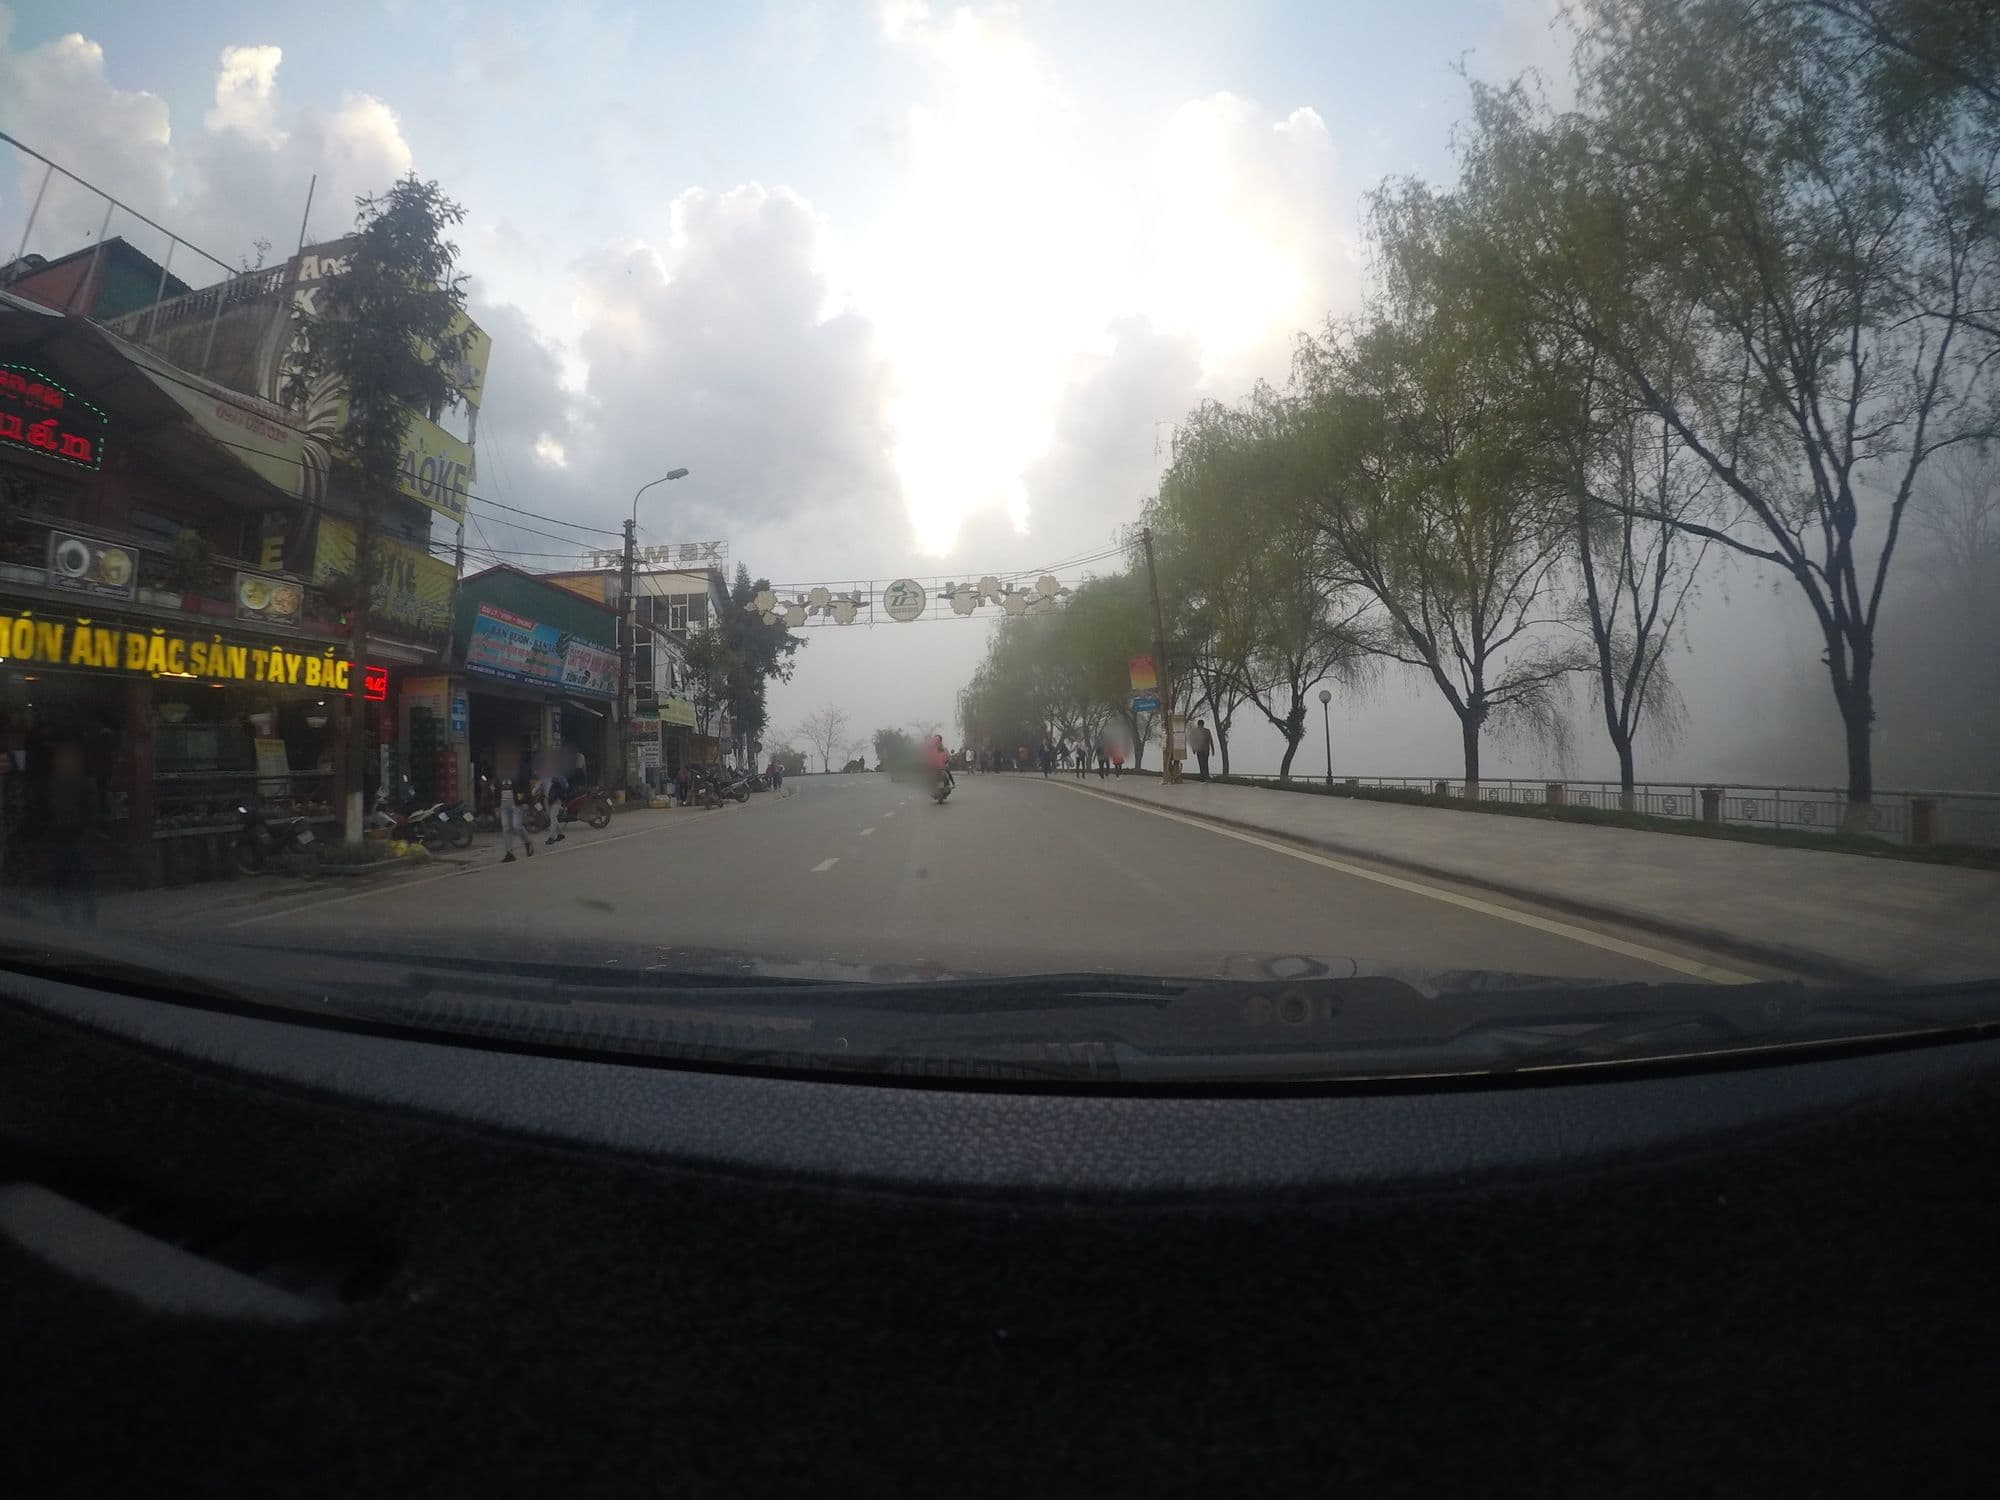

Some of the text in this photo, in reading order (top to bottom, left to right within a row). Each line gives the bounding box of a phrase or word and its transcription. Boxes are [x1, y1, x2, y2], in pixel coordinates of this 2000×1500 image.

[69, 618, 119, 668] ĂN
[190, 634, 249, 680] SẢN
[251, 645, 303, 686] TÂY
[305, 646, 350, 690] BẮC
